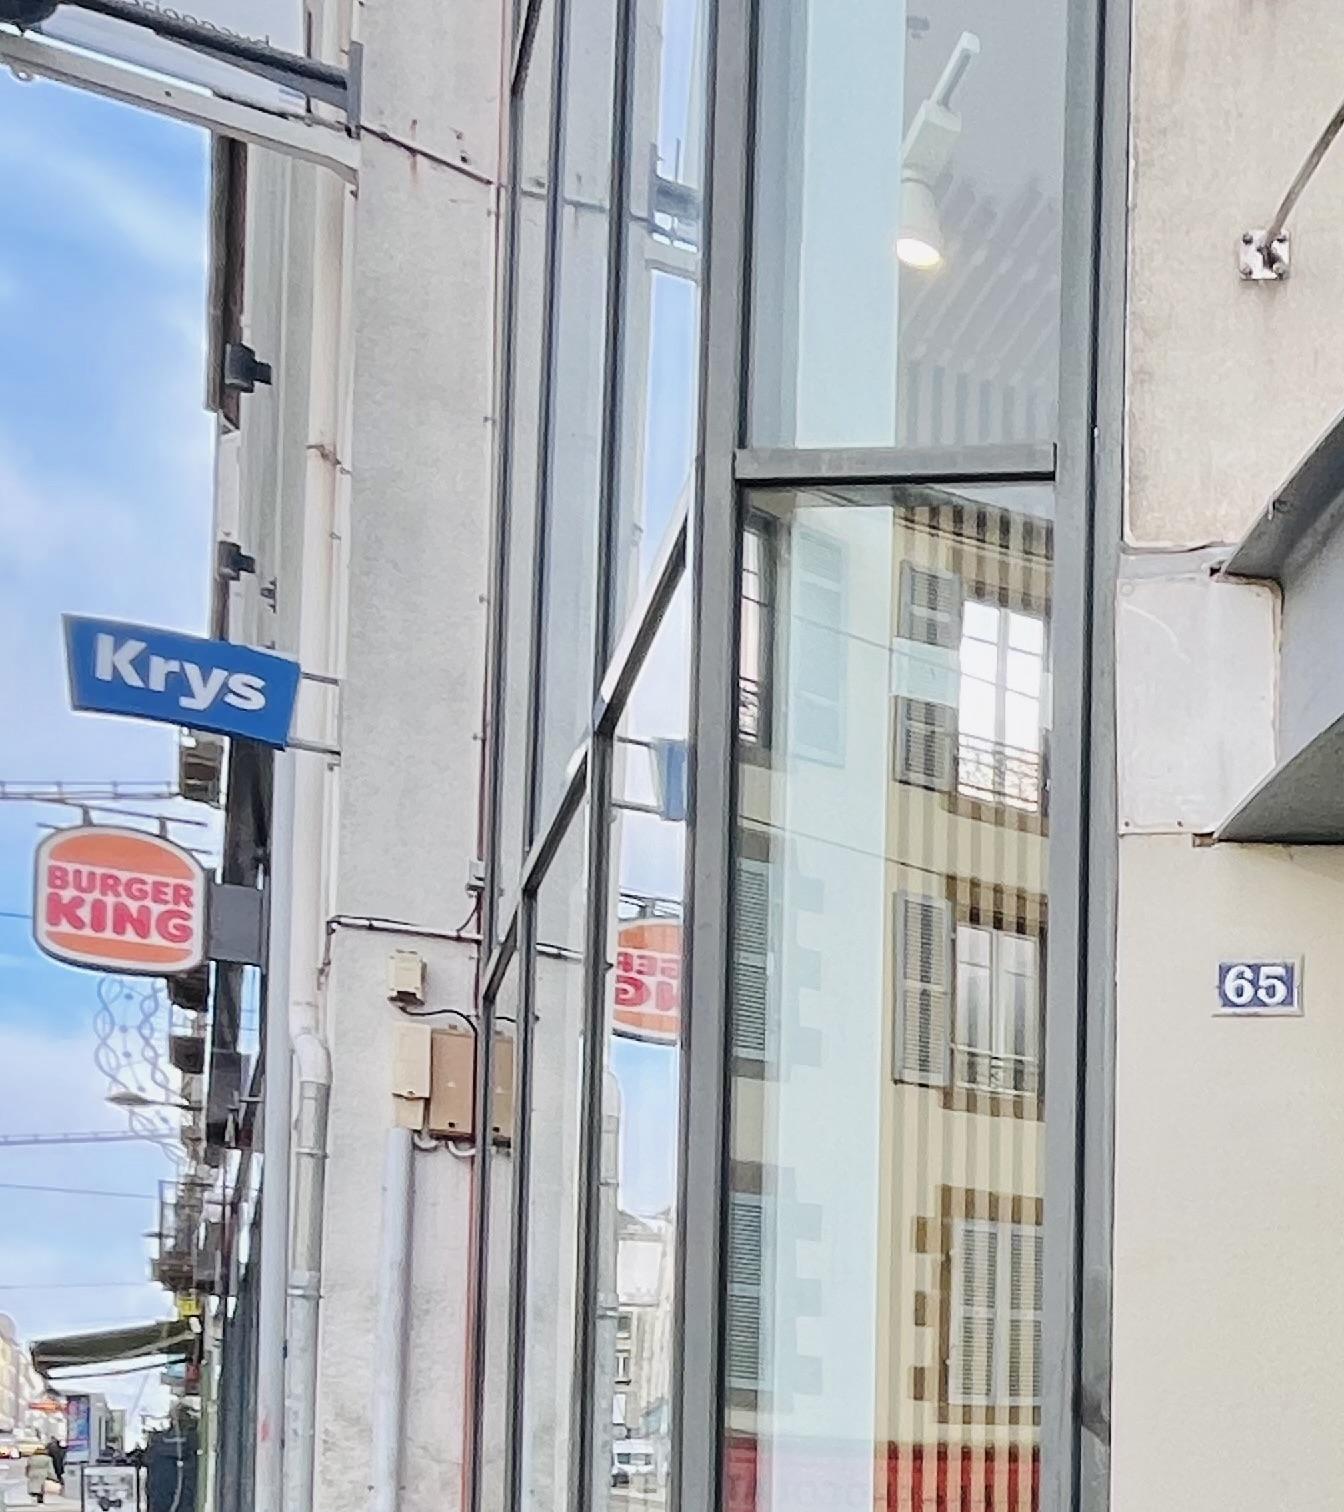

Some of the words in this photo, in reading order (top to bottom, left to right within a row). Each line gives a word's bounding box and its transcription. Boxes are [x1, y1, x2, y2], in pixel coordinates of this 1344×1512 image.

[95, 632, 267, 712] Krys
[46, 864, 194, 908] BURGER
[46, 892, 194, 944] KING
[1225, 964, 1288, 1006] 65
